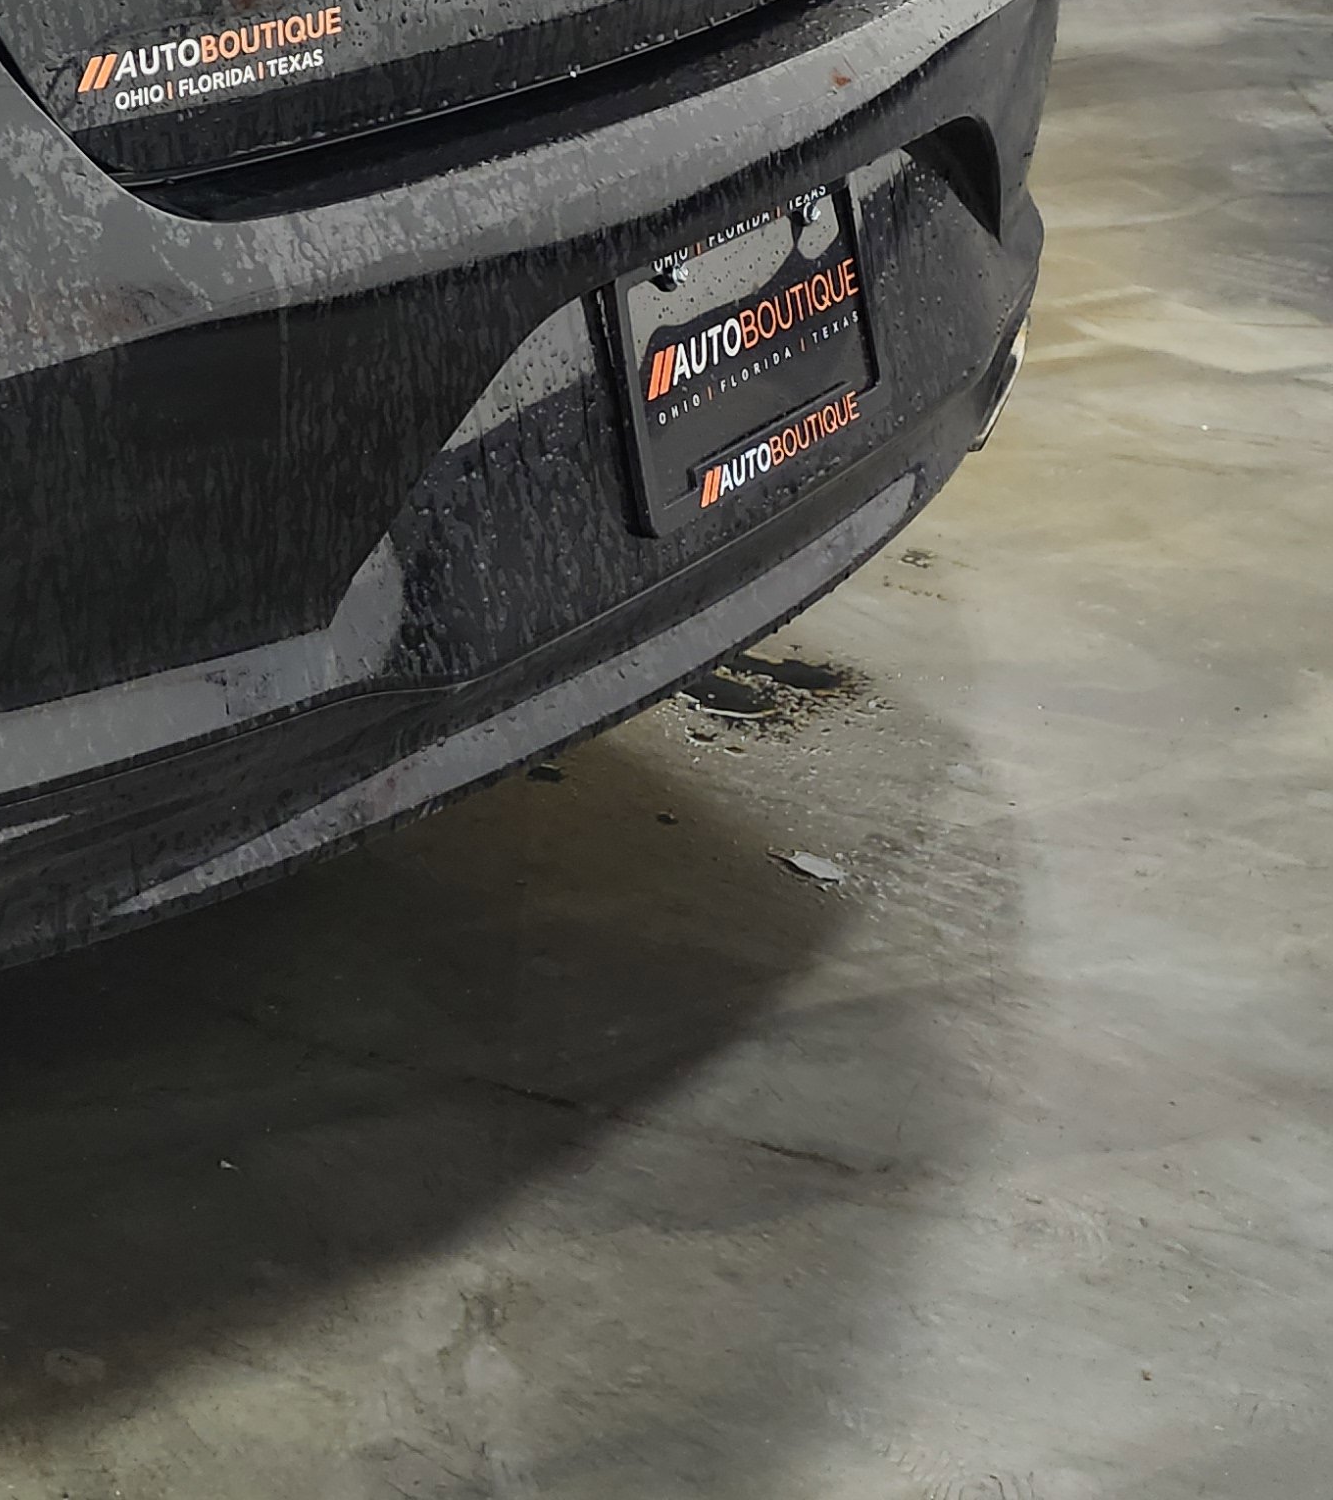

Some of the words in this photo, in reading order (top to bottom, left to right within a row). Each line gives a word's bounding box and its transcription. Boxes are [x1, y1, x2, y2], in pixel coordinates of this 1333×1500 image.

[114, 83, 164, 110] OHIO
[177, 66, 257, 99] FLORIDA
[267, 49, 325, 78] TEXAS
[658, 393, 701, 426] OHIO
[719, 347, 793, 393] FLORIDA
[811, 309, 860, 345] TEXAS
